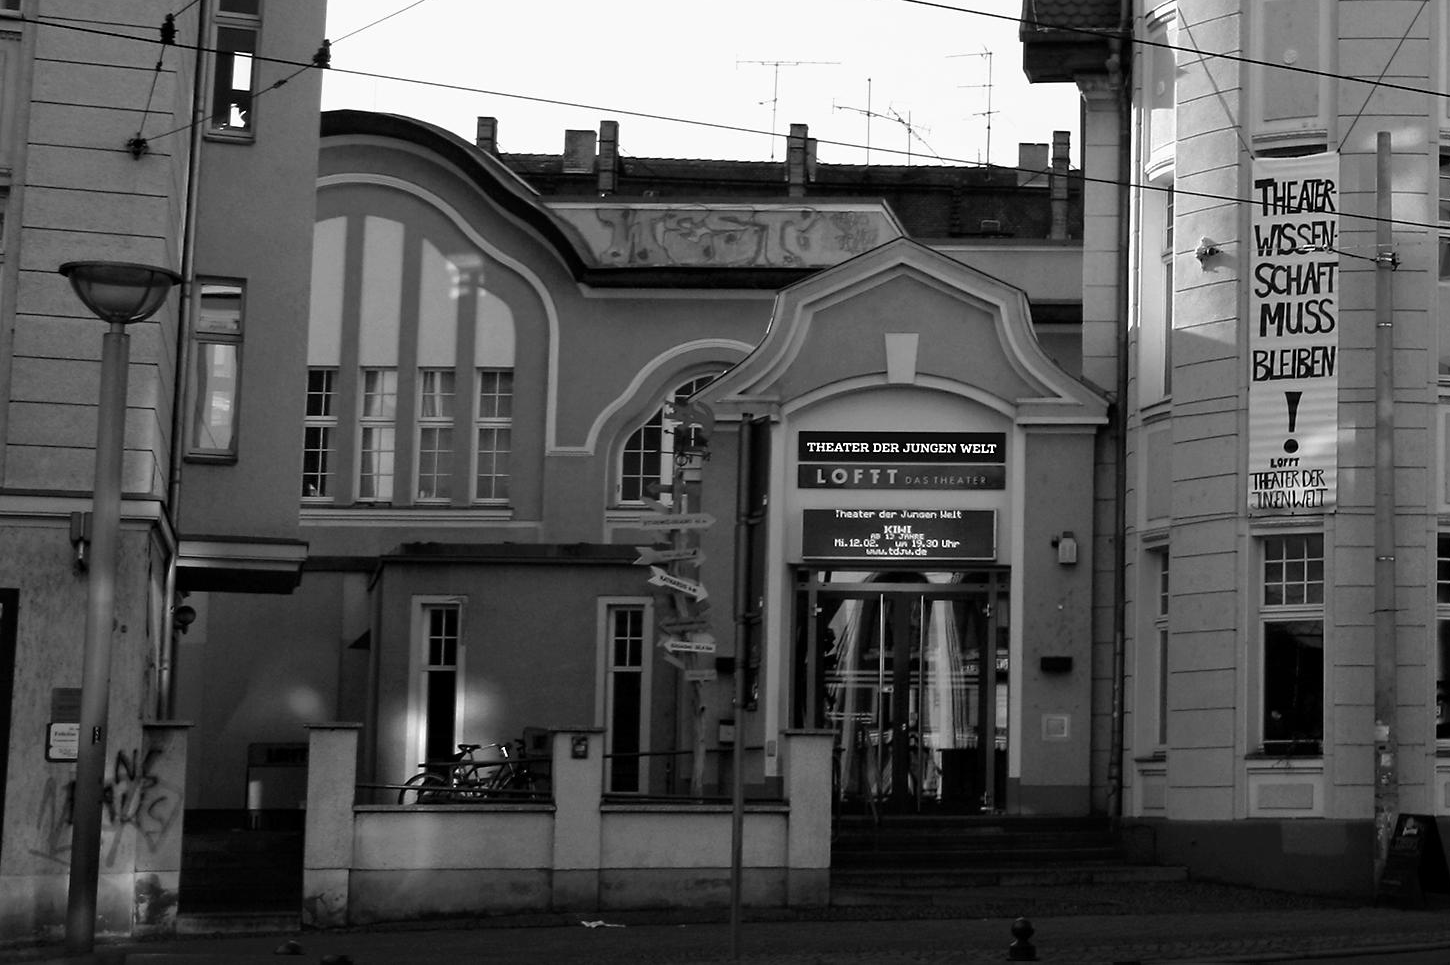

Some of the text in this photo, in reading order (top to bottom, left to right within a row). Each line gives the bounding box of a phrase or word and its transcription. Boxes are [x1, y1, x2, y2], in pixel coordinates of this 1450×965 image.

[1254, 261, 1339, 298] SCHAFT
[1259, 298, 1336, 337] MUSS
[1252, 345, 1336, 382] BLEIBEN
[807, 442, 997, 454] THEATER DER JUNGEN WELT
[1270, 457, 1300, 469] LOFFT
[816, 468, 988, 484] LOFFT DAS THEATER
[1250, 468, 1326, 491] THEATER DER
[1292, 487, 1329, 509] WELT
[835, 509, 876, 519] Theater
[879, 509, 898, 519] der
[940, 510, 962, 519] Welt
[883, 525, 912, 534] KIWI
[911, 539, 938, 548] 19.30
[941, 539, 960, 548] Uhr
